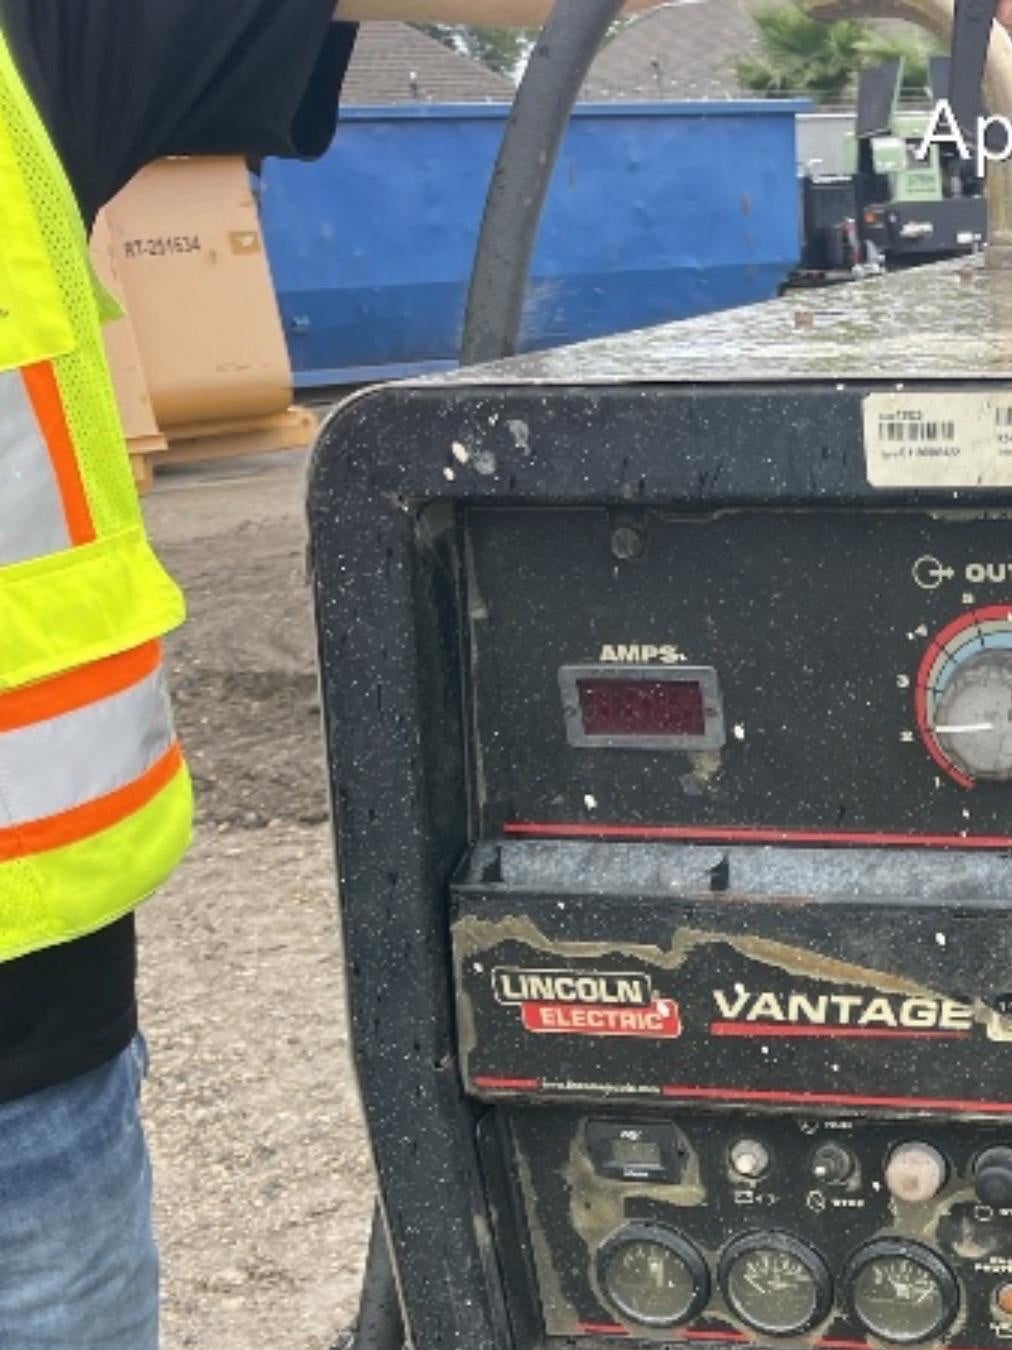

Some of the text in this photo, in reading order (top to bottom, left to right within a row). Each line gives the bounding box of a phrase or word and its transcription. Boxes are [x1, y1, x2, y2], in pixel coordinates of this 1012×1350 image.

[600, 645, 680, 664] AMPS
[501, 974, 643, 1003] LINCOLN
[539, 1007, 664, 1031] ELECTRIC
[713, 989, 974, 1030] VANTAGE
